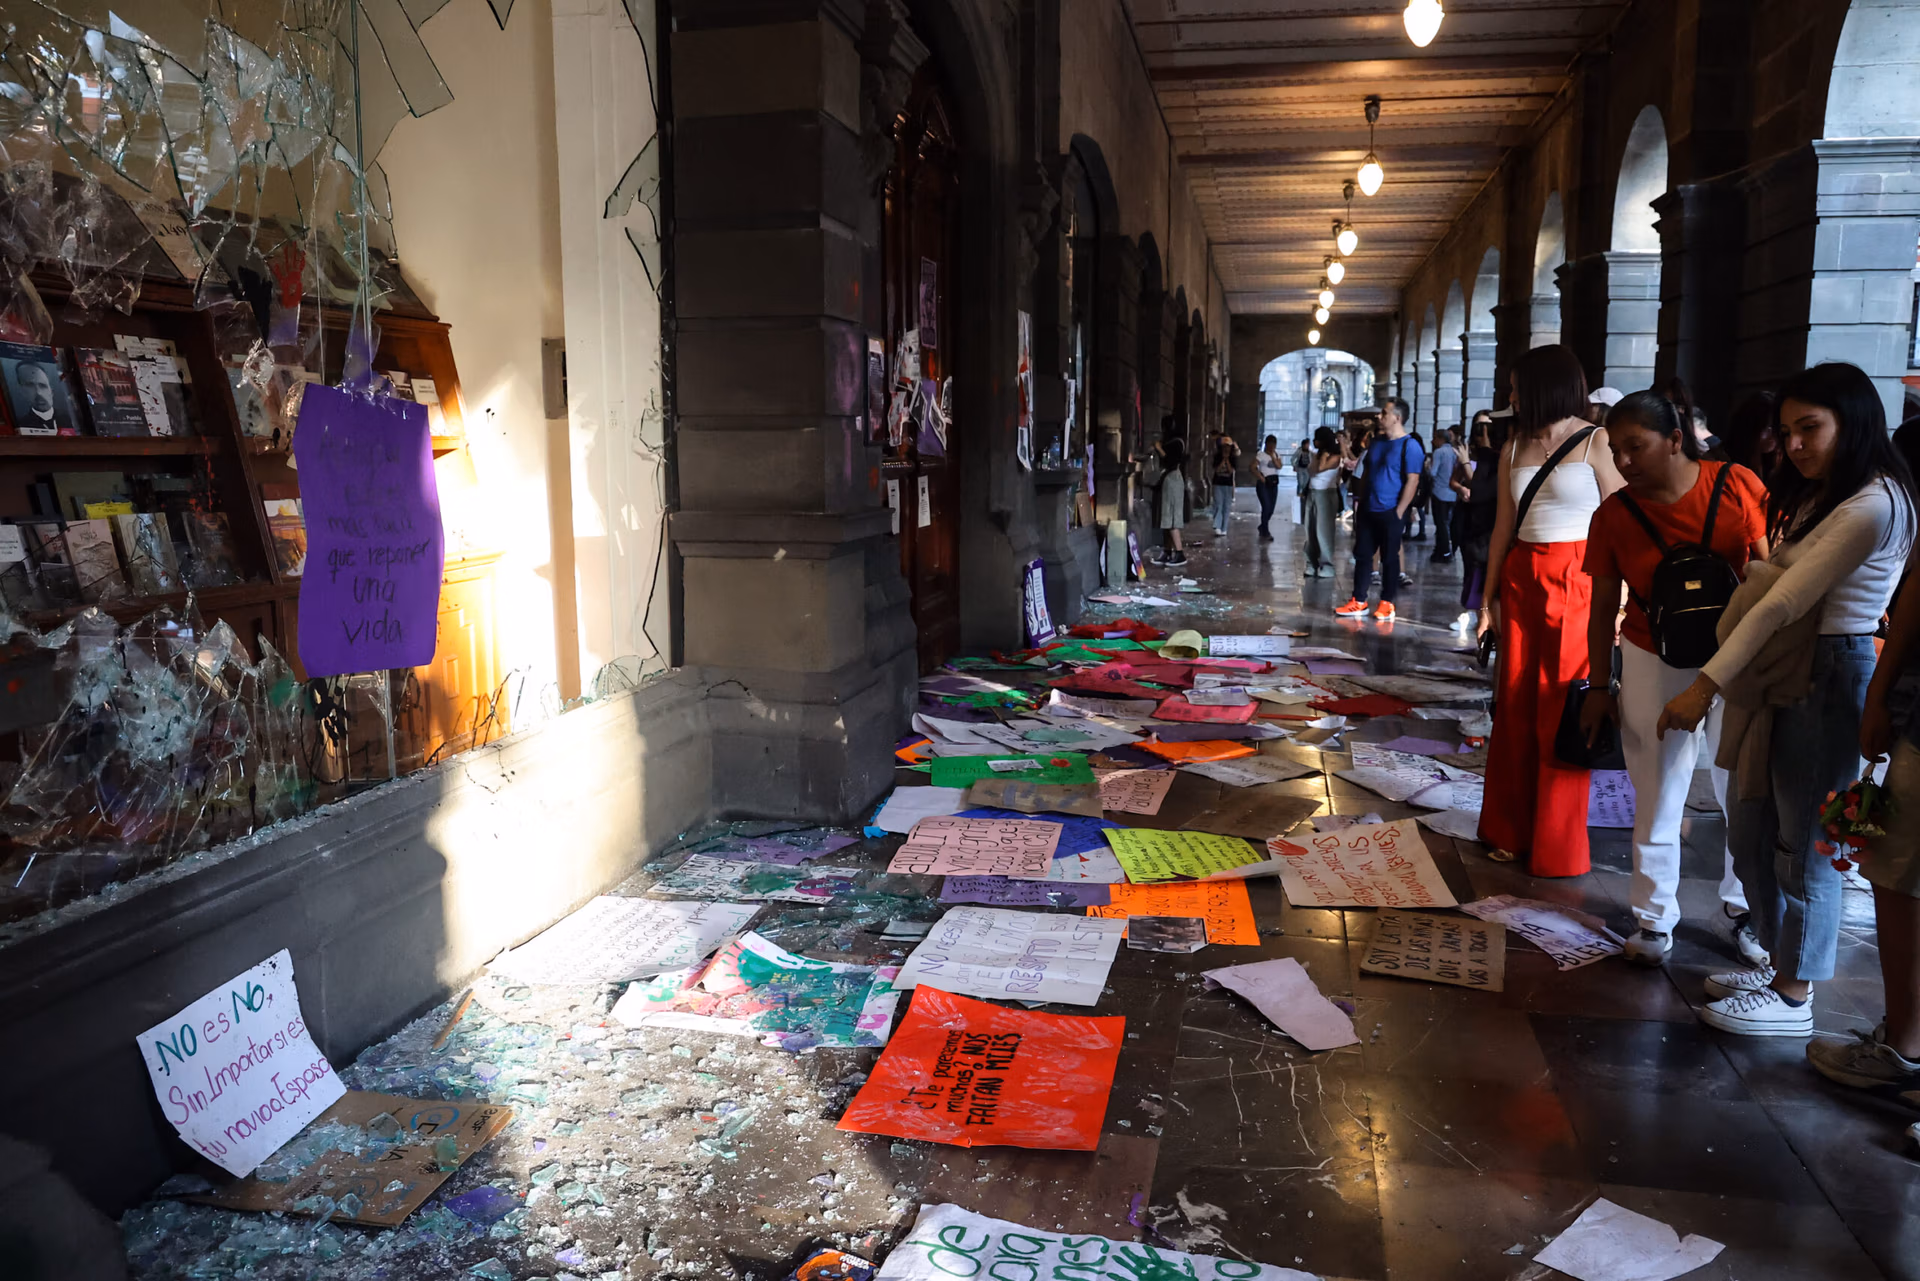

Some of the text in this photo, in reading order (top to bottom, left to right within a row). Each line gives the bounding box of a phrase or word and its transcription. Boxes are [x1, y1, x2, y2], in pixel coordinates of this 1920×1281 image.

[328, 538, 431, 583] que reponer
[917, 953, 949, 976] NO
[1365, 947, 1403, 970] SOY
[1402, 953, 1431, 970] DE
[1435, 958, 1462, 979] QUE
[1465, 967, 1489, 987] VAS
[203, 1012, 230, 1044] es
[287, 1016, 306, 1039] es
[934, 1030, 963, 1078] parecemos
[987, 1033, 1023, 1069] MILES
[947, 1033, 986, 1112] muchas? NOS
[193, 1138, 227, 1159] tu
[906, 1225, 990, 1278] de
